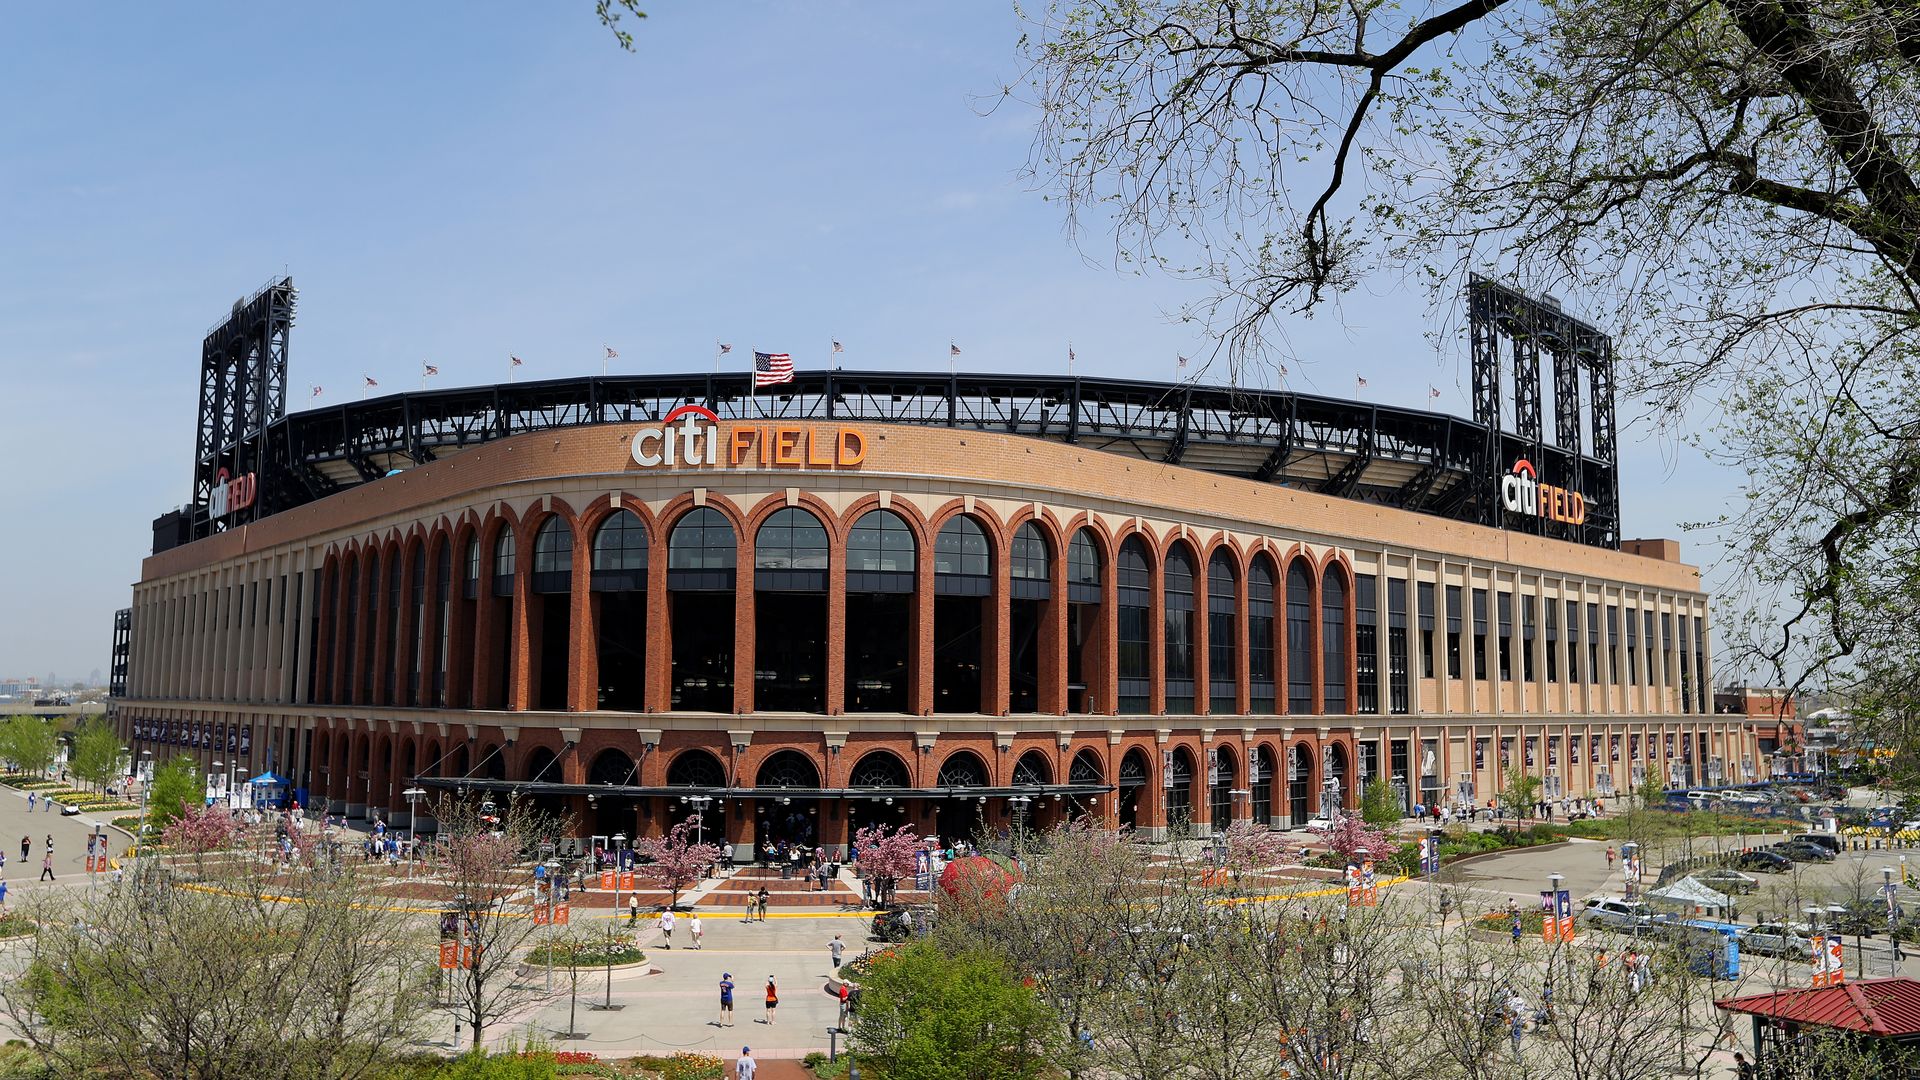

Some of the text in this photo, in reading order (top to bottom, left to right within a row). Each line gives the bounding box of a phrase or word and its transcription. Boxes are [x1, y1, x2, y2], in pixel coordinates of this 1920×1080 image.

[631, 415, 868, 467] citi FIELD
[209, 472, 257, 520] citi FIELD
[1502, 469, 1585, 525] citi FIELD
